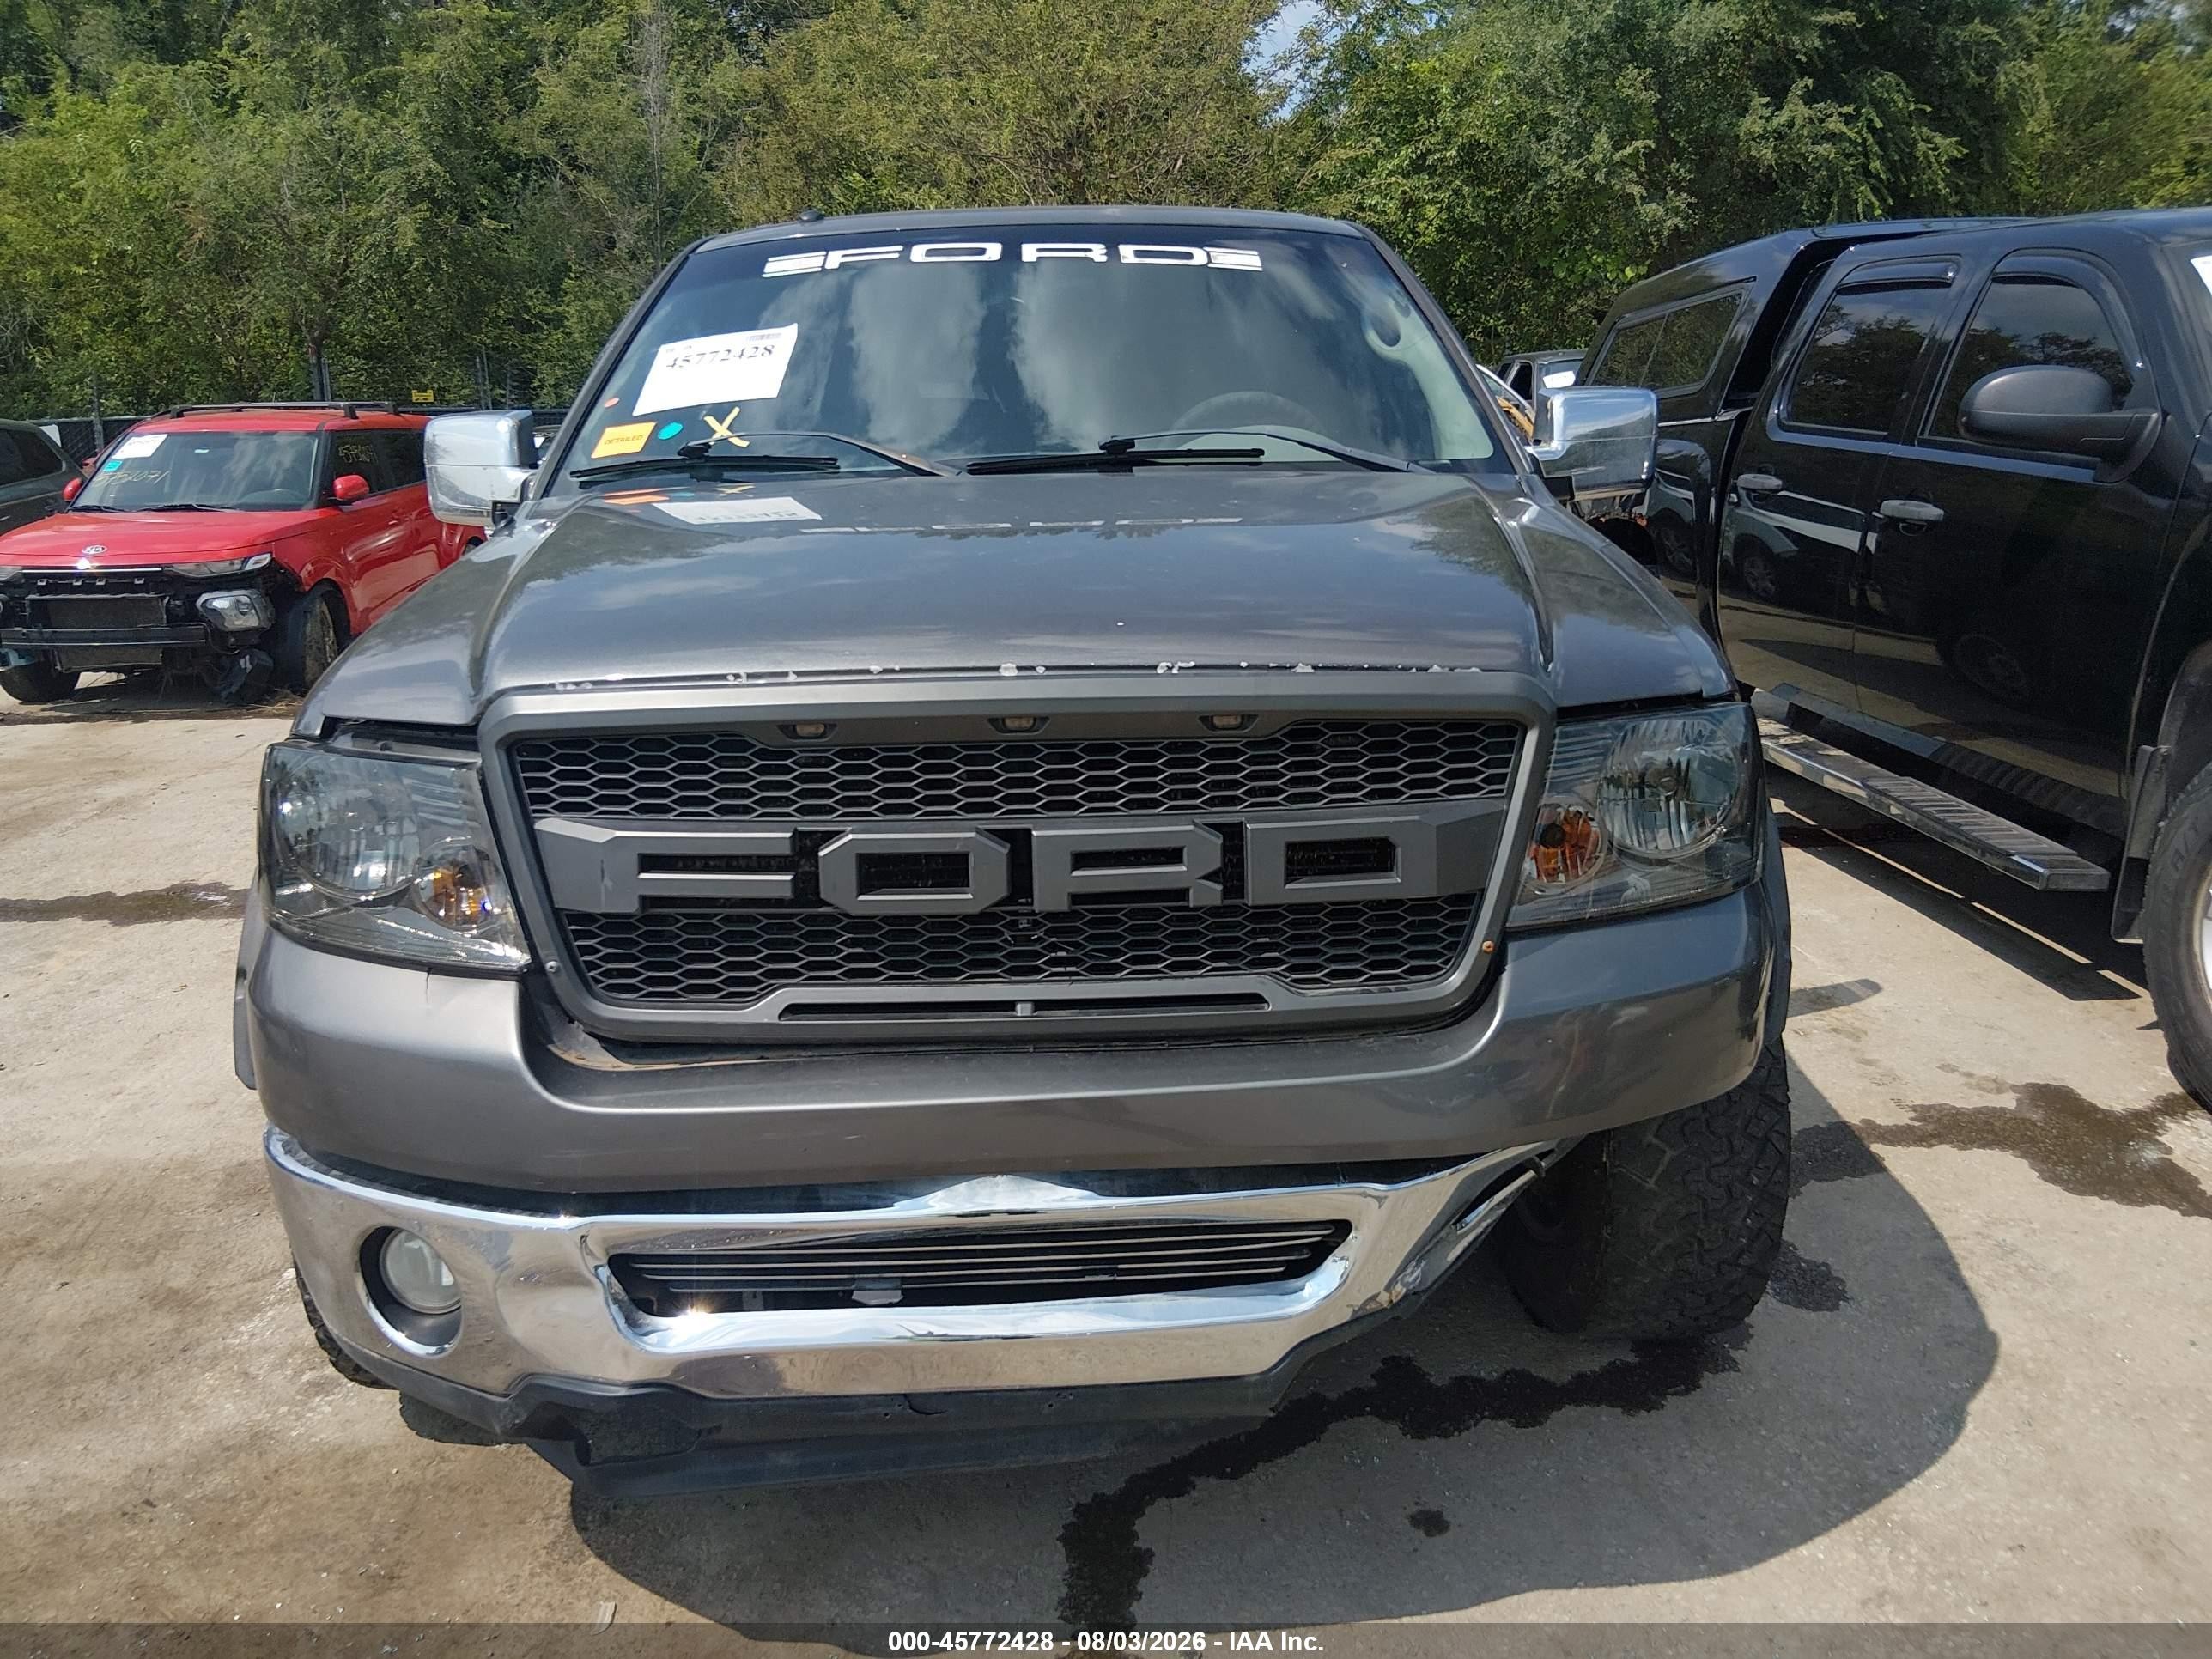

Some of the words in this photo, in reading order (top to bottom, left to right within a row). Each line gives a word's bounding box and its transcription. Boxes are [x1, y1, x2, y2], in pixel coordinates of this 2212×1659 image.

[823, 242, 1210, 269] FORD
[665, 344, 775, 369] 45772428
[604, 434, 644, 446] DETAILED
[550, 817, 1453, 915] FORD
